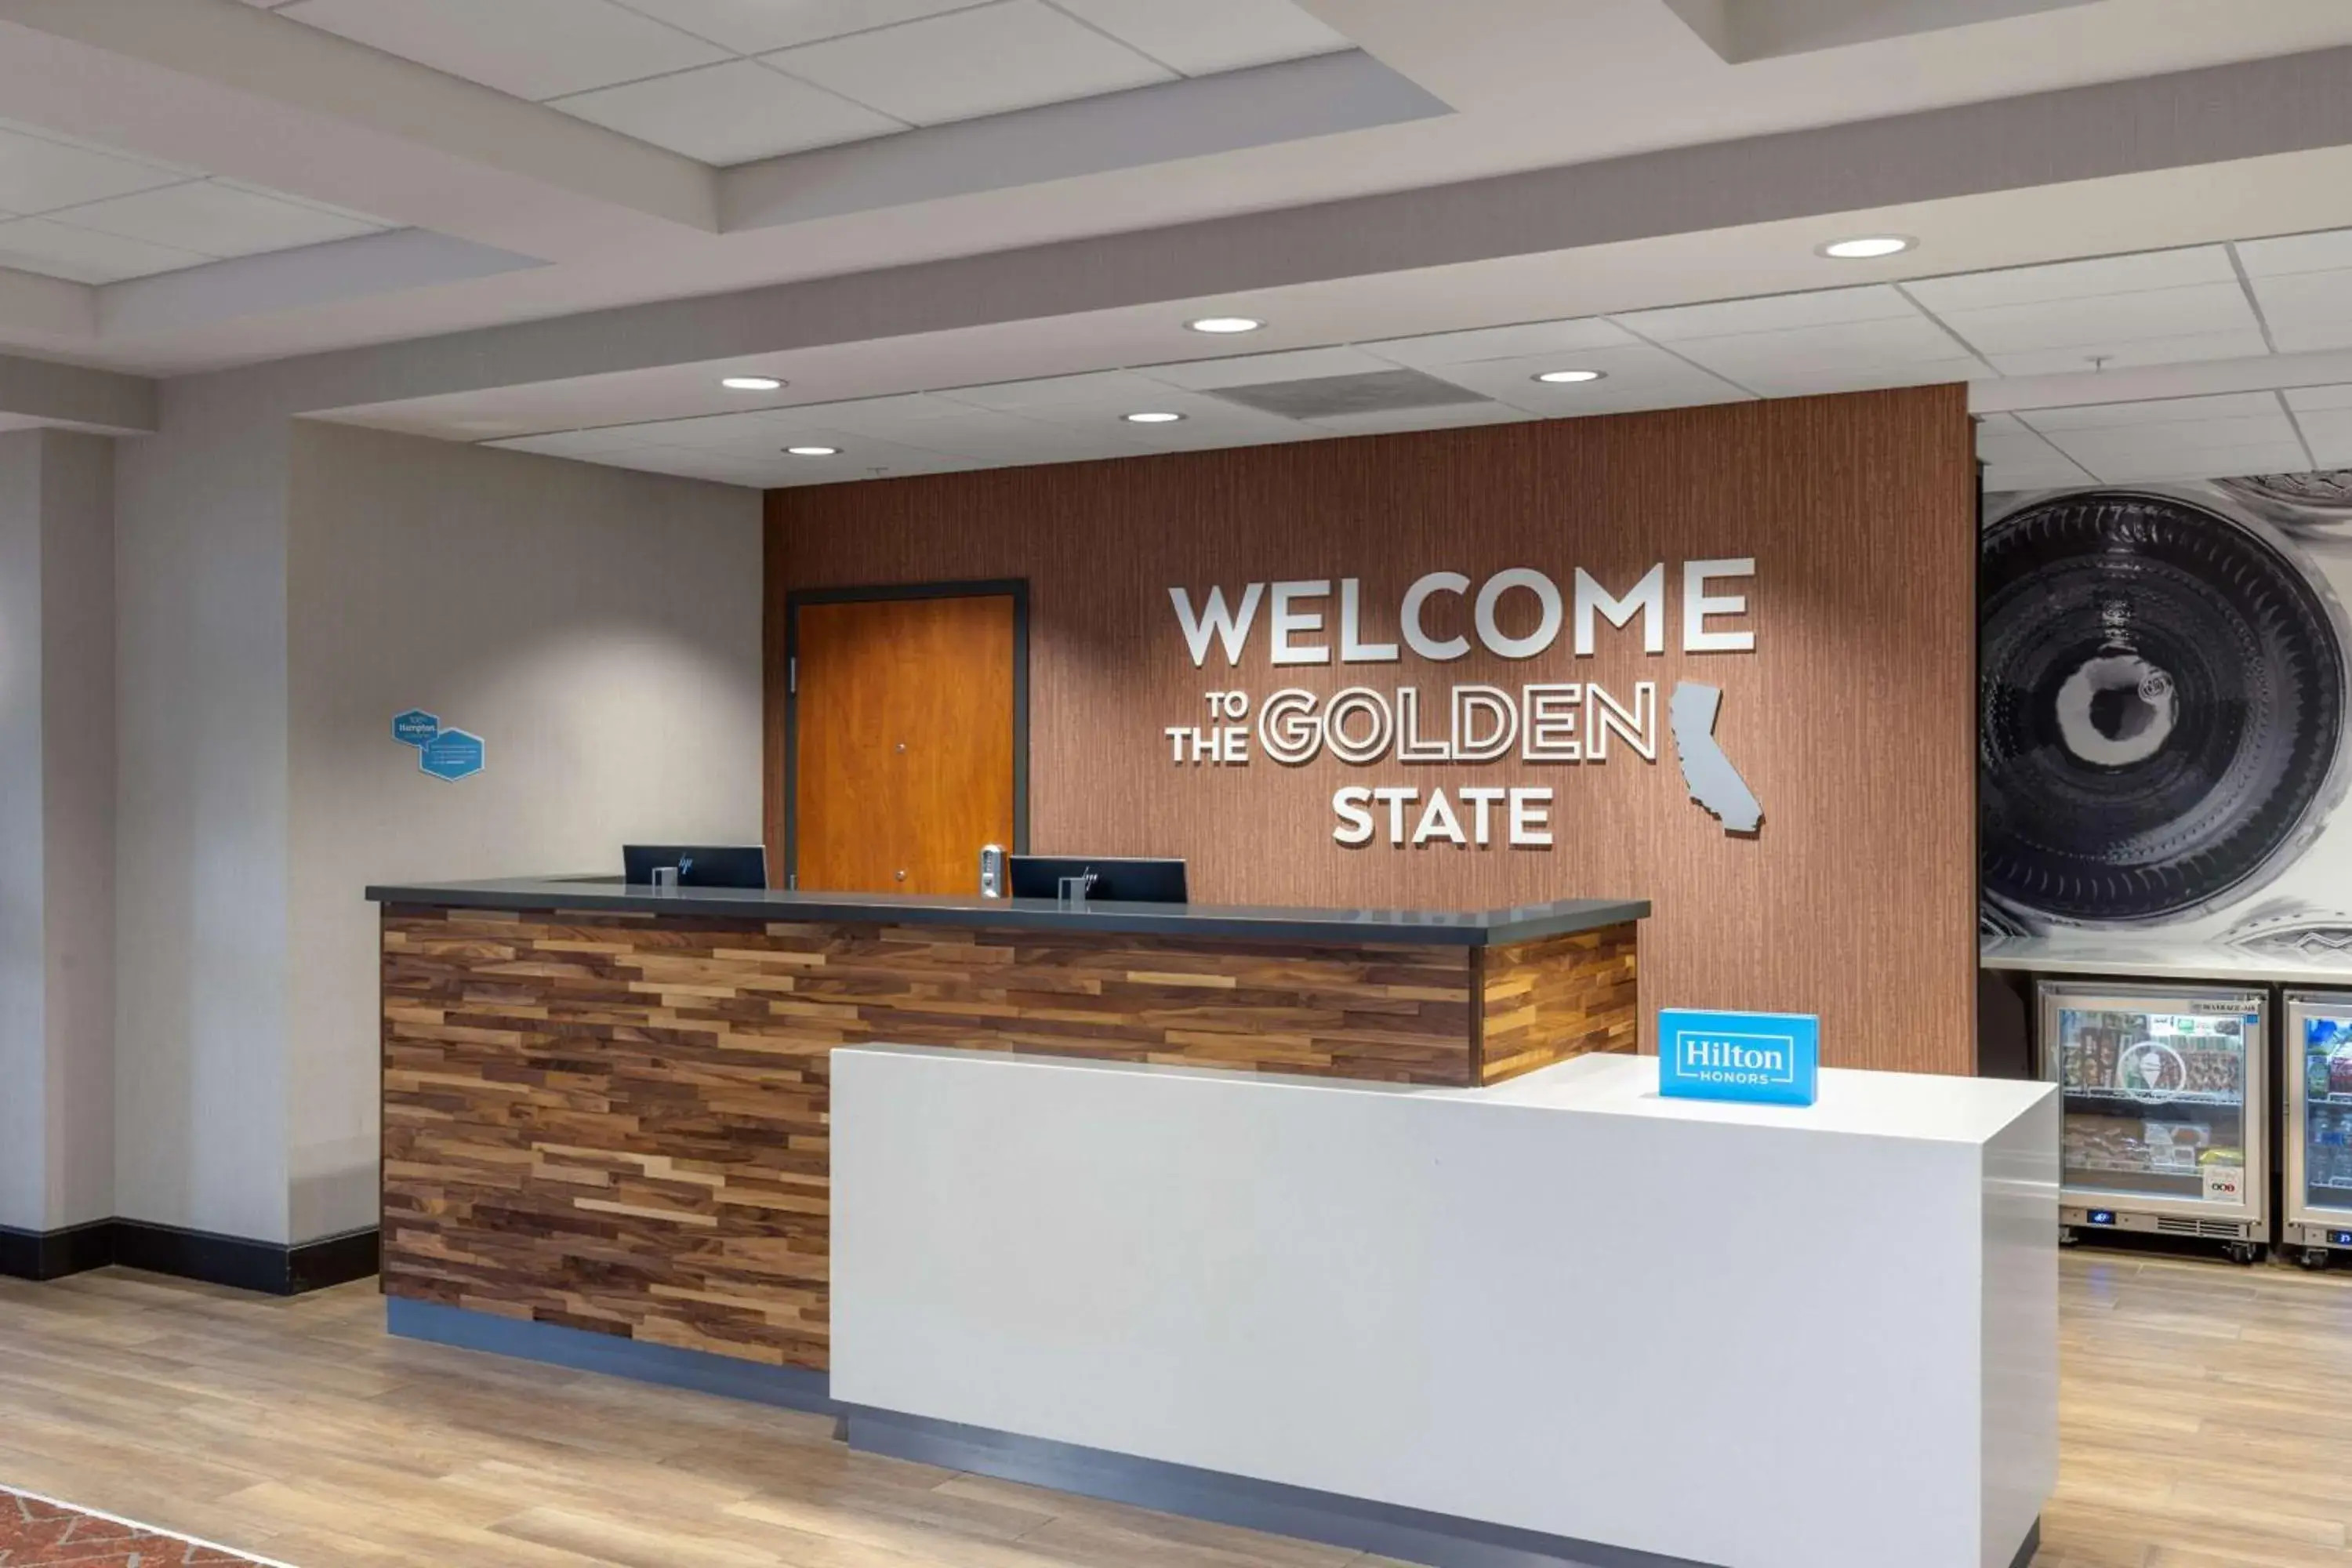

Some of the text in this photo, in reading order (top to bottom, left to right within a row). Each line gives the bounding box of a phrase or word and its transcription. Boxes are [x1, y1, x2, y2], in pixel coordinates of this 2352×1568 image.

[1168, 557, 1756, 667] WELCOME
[1206, 691, 1249, 719] TO
[1258, 681, 1657, 764] GOLDEN
[1165, 727, 1250, 762] THE
[1332, 787, 1554, 845] STATE
[1686, 1040, 1783, 1070] Hilton
[1700, 1071, 1769, 1085] HONORS
